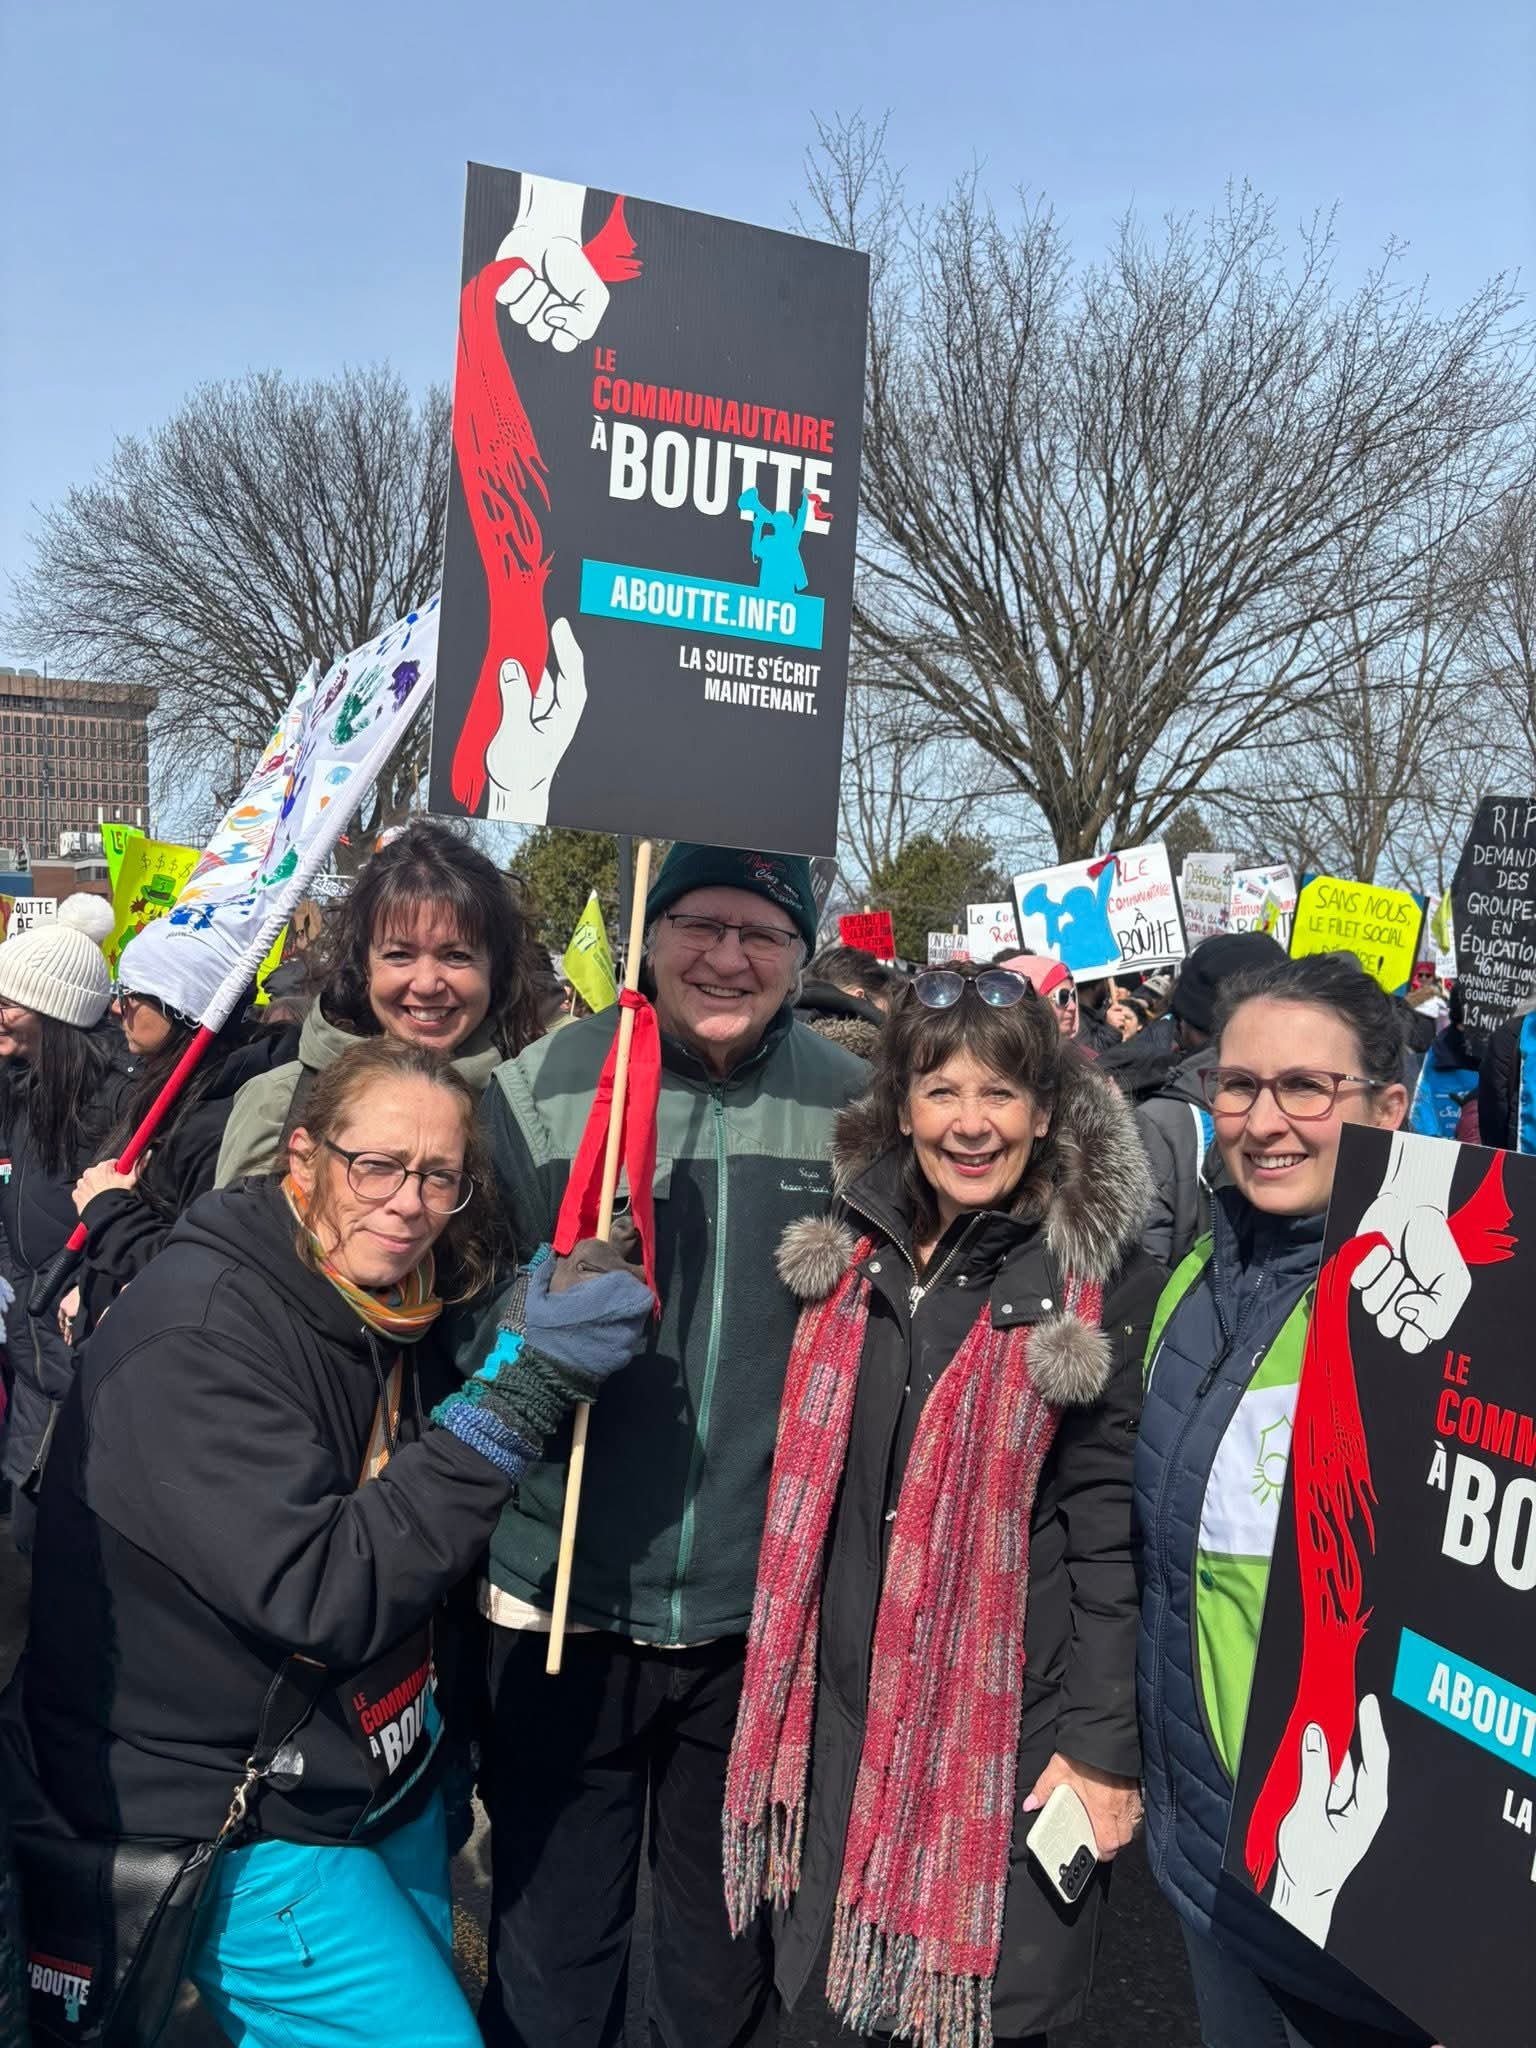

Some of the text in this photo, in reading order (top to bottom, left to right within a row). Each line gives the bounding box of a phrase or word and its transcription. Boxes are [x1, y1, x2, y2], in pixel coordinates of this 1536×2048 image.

[594, 347, 617, 373] LE
[592, 375, 835, 454] COMMUNAUTAIRE
[590, 414, 833, 535] À BOUTTE
[609, 575, 796, 636] ABOUTTE.INFO
[679, 645, 821, 687] LA SUITE S'ÉCRIT
[704, 677, 818, 715] MAINTENANT.
[1492, 805, 1536, 843] RIP
[1123, 858, 1149, 883] LE
[1496, 869, 1529, 890] DES
[13, 902, 53, 915] OUTTE
[969, 909, 984, 925] Le
[1315, 885, 1411, 926] SANS NOUS,
[1467, 892, 1536, 920] GROUPE
[17, 917, 33, 929] DE
[1309, 916, 1324, 933] LE
[1328, 917, 1362, 938] FILET
[1491, 919, 1513, 935] EN
[1514, 982, 1530, 996] DU
[1443, 1350, 1471, 1386] LE
[1426, 1439, 1536, 1591] À BO
[352, 1692, 368, 1711] LE
[1427, 1661, 1536, 1758] ABOUT
[368, 1736, 381, 1758] À
[1502, 1788, 1533, 1834] LA
[31, 1964, 91, 2006] BOUTTE
